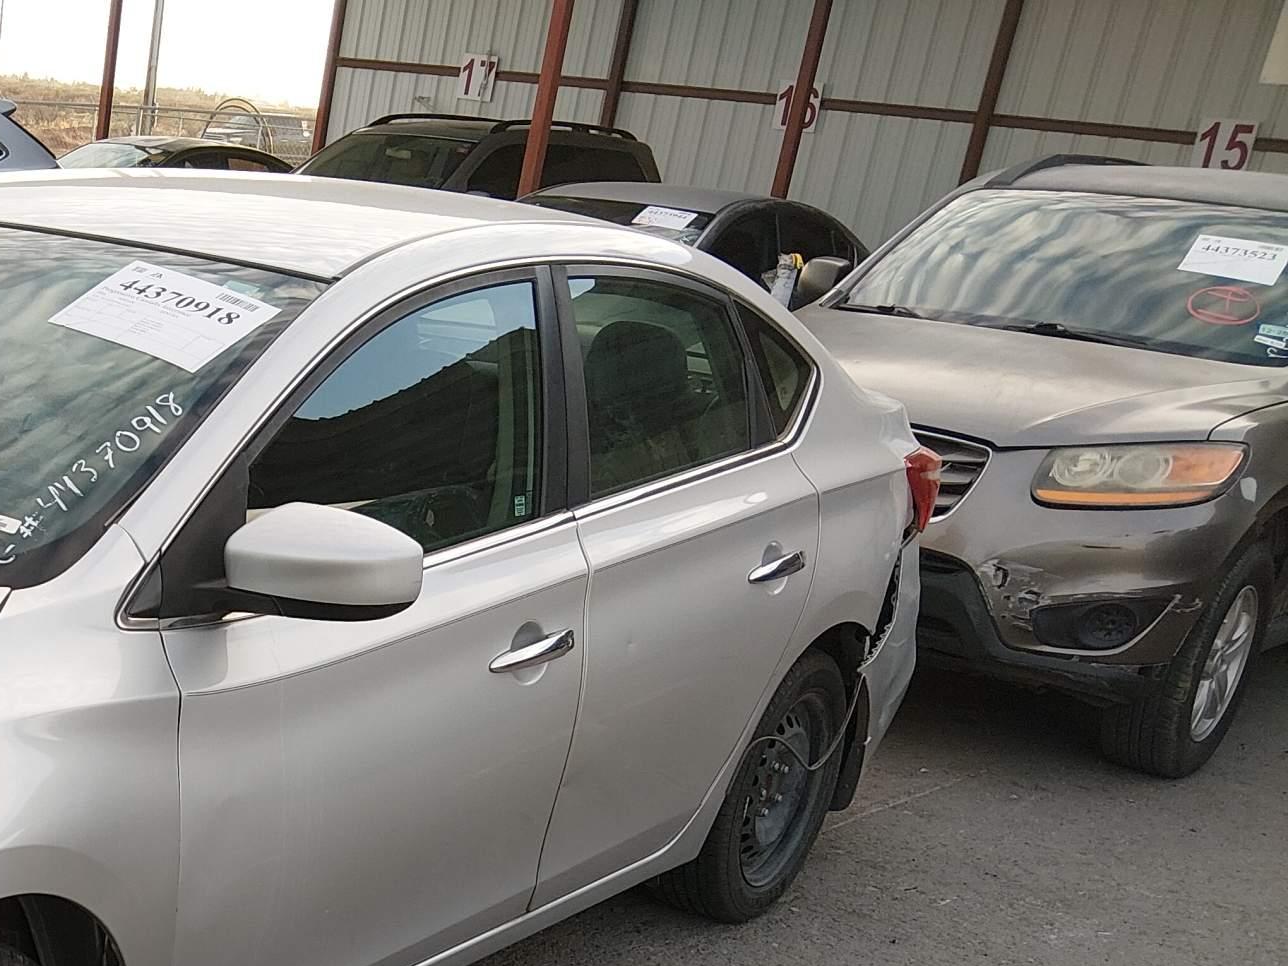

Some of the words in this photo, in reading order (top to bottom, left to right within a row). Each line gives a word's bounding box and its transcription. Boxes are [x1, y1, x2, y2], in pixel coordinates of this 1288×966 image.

[462, 58, 496, 96] 17
[779, 85, 819, 128] 16
[1199, 122, 1254, 169] 15
[120, 279, 241, 325] 44370918
[37, 392, 182, 511] 44370918
